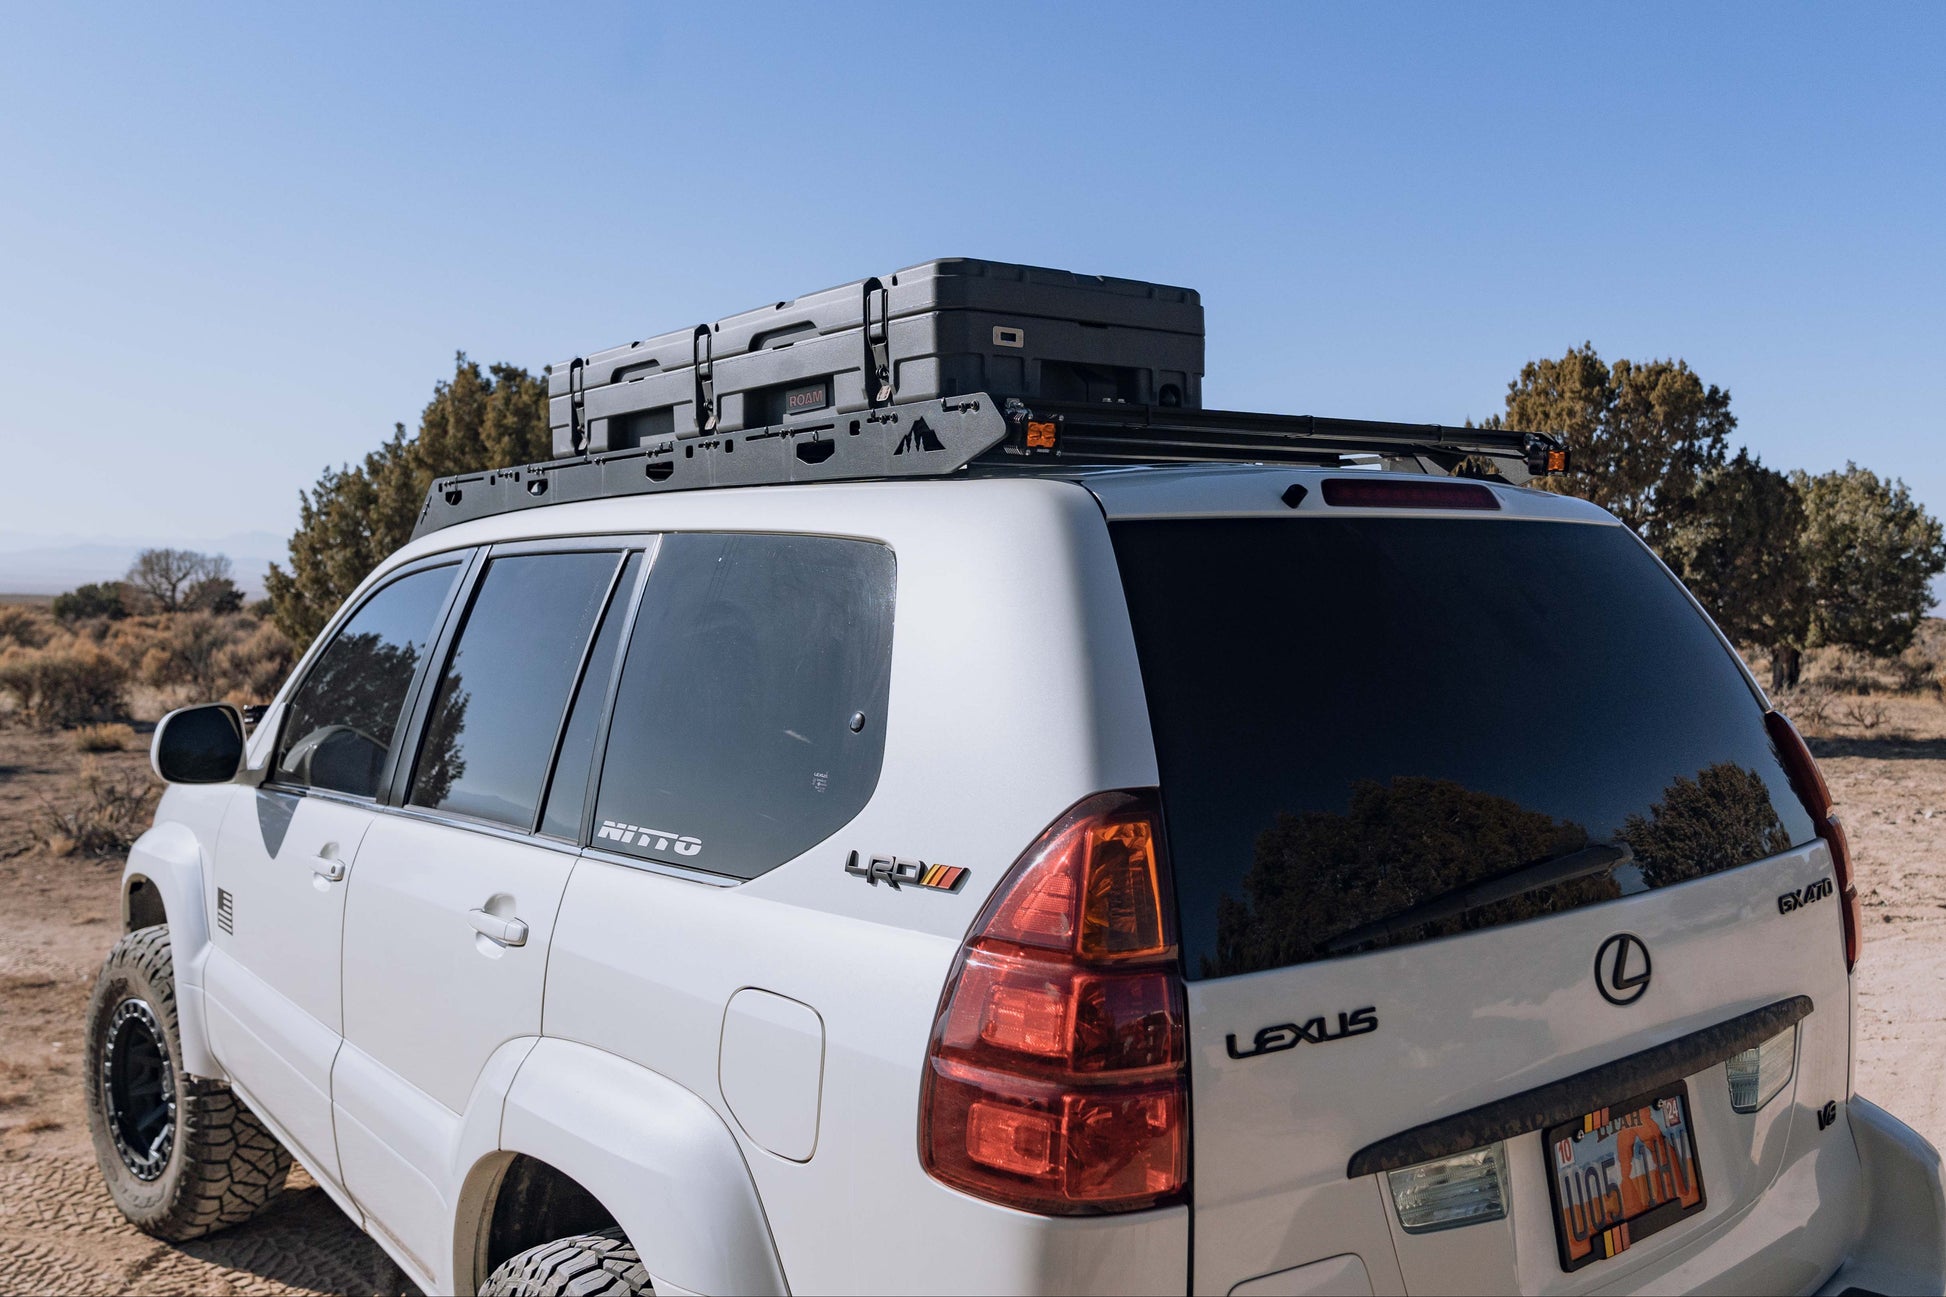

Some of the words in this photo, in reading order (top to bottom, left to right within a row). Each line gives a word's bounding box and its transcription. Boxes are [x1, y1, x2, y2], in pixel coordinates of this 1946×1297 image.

[789, 391, 823, 407] ROAM
[598, 820, 702, 856] NITTO
[845, 850, 928, 892] LRD
[1778, 877, 1833, 914] GX470
[1225, 1006, 1379, 1060] LEXUS
[1666, 1099, 1679, 1120] 24
[1817, 1100, 1836, 1131] V8
[1558, 1140, 1573, 1165] 10
